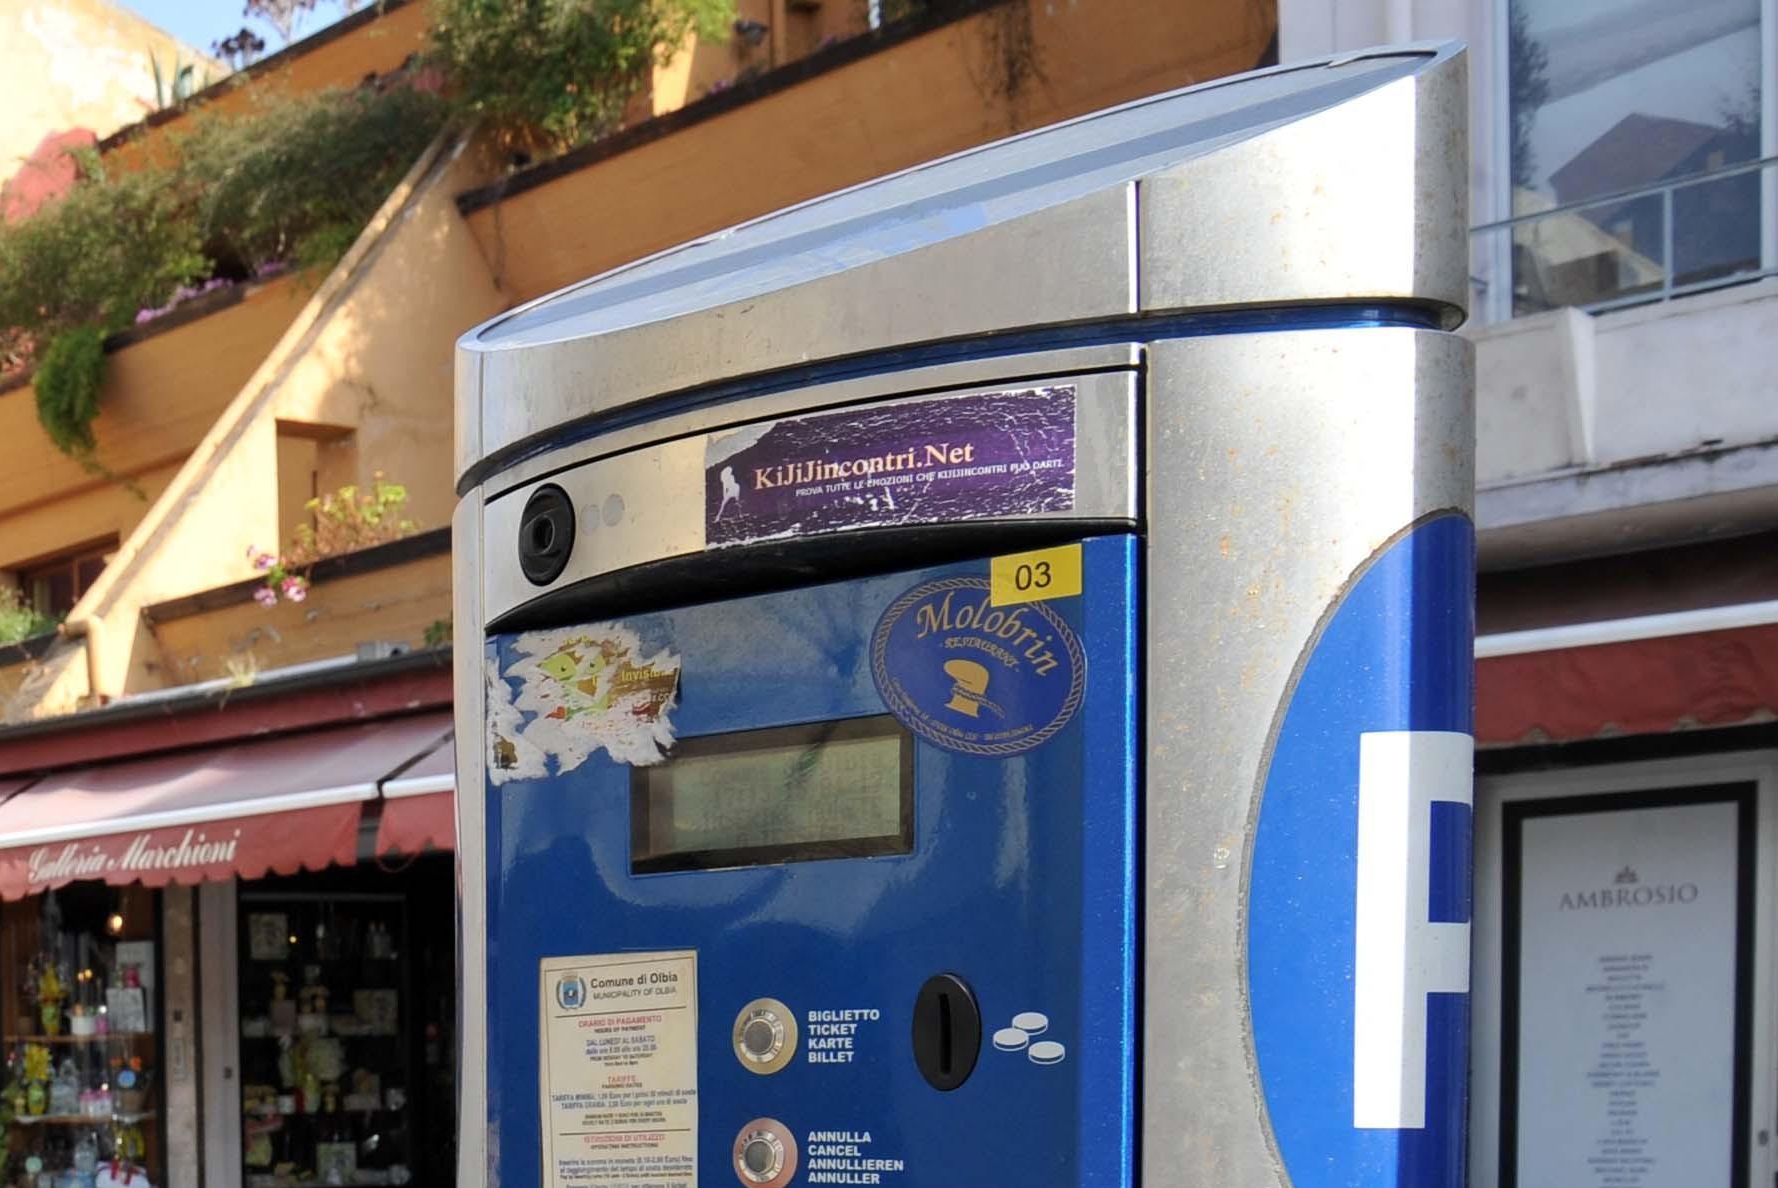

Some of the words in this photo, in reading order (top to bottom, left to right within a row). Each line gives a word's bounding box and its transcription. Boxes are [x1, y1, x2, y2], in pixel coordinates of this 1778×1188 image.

[795, 487, 823, 497] PROVA
[825, 483, 851, 494] TUTTE
[853, 480, 864, 490] LE
[867, 474, 914, 487] EMOZIONI
[916, 471, 935, 482] CHE
[1015, 562, 1052, 591] 03
[916, 590, 1060, 678] Molobrin
[28, 842, 107, 883] Galleria
[108, 828, 241, 872] Marchioni
[1559, 883, 1699, 911] AMBROSIO
[590, 976, 634, 989] Comune
[637, 974, 647, 985] di
[649, 971, 678, 985] Olbia
[592, 989, 642, 1001] MUNICIPALITY
[643, 988, 652, 997] OF
[653, 986, 678, 996] OLBIA
[616, 1015, 662, 1026] PAGAMENTO
[808, 1008, 880, 1022] BIGLIETTO
[808, 1023, 858, 1035] TICKET
[808, 1037, 854, 1049] KARTE
[808, 1051, 855, 1063] BILLET
[808, 1131, 872, 1143] ANNULLA
[808, 1144, 862, 1157] CANCEL
[808, 1158, 904, 1171] ANNULLIEREN
[808, 1171, 880, 1185] ANNULLER
